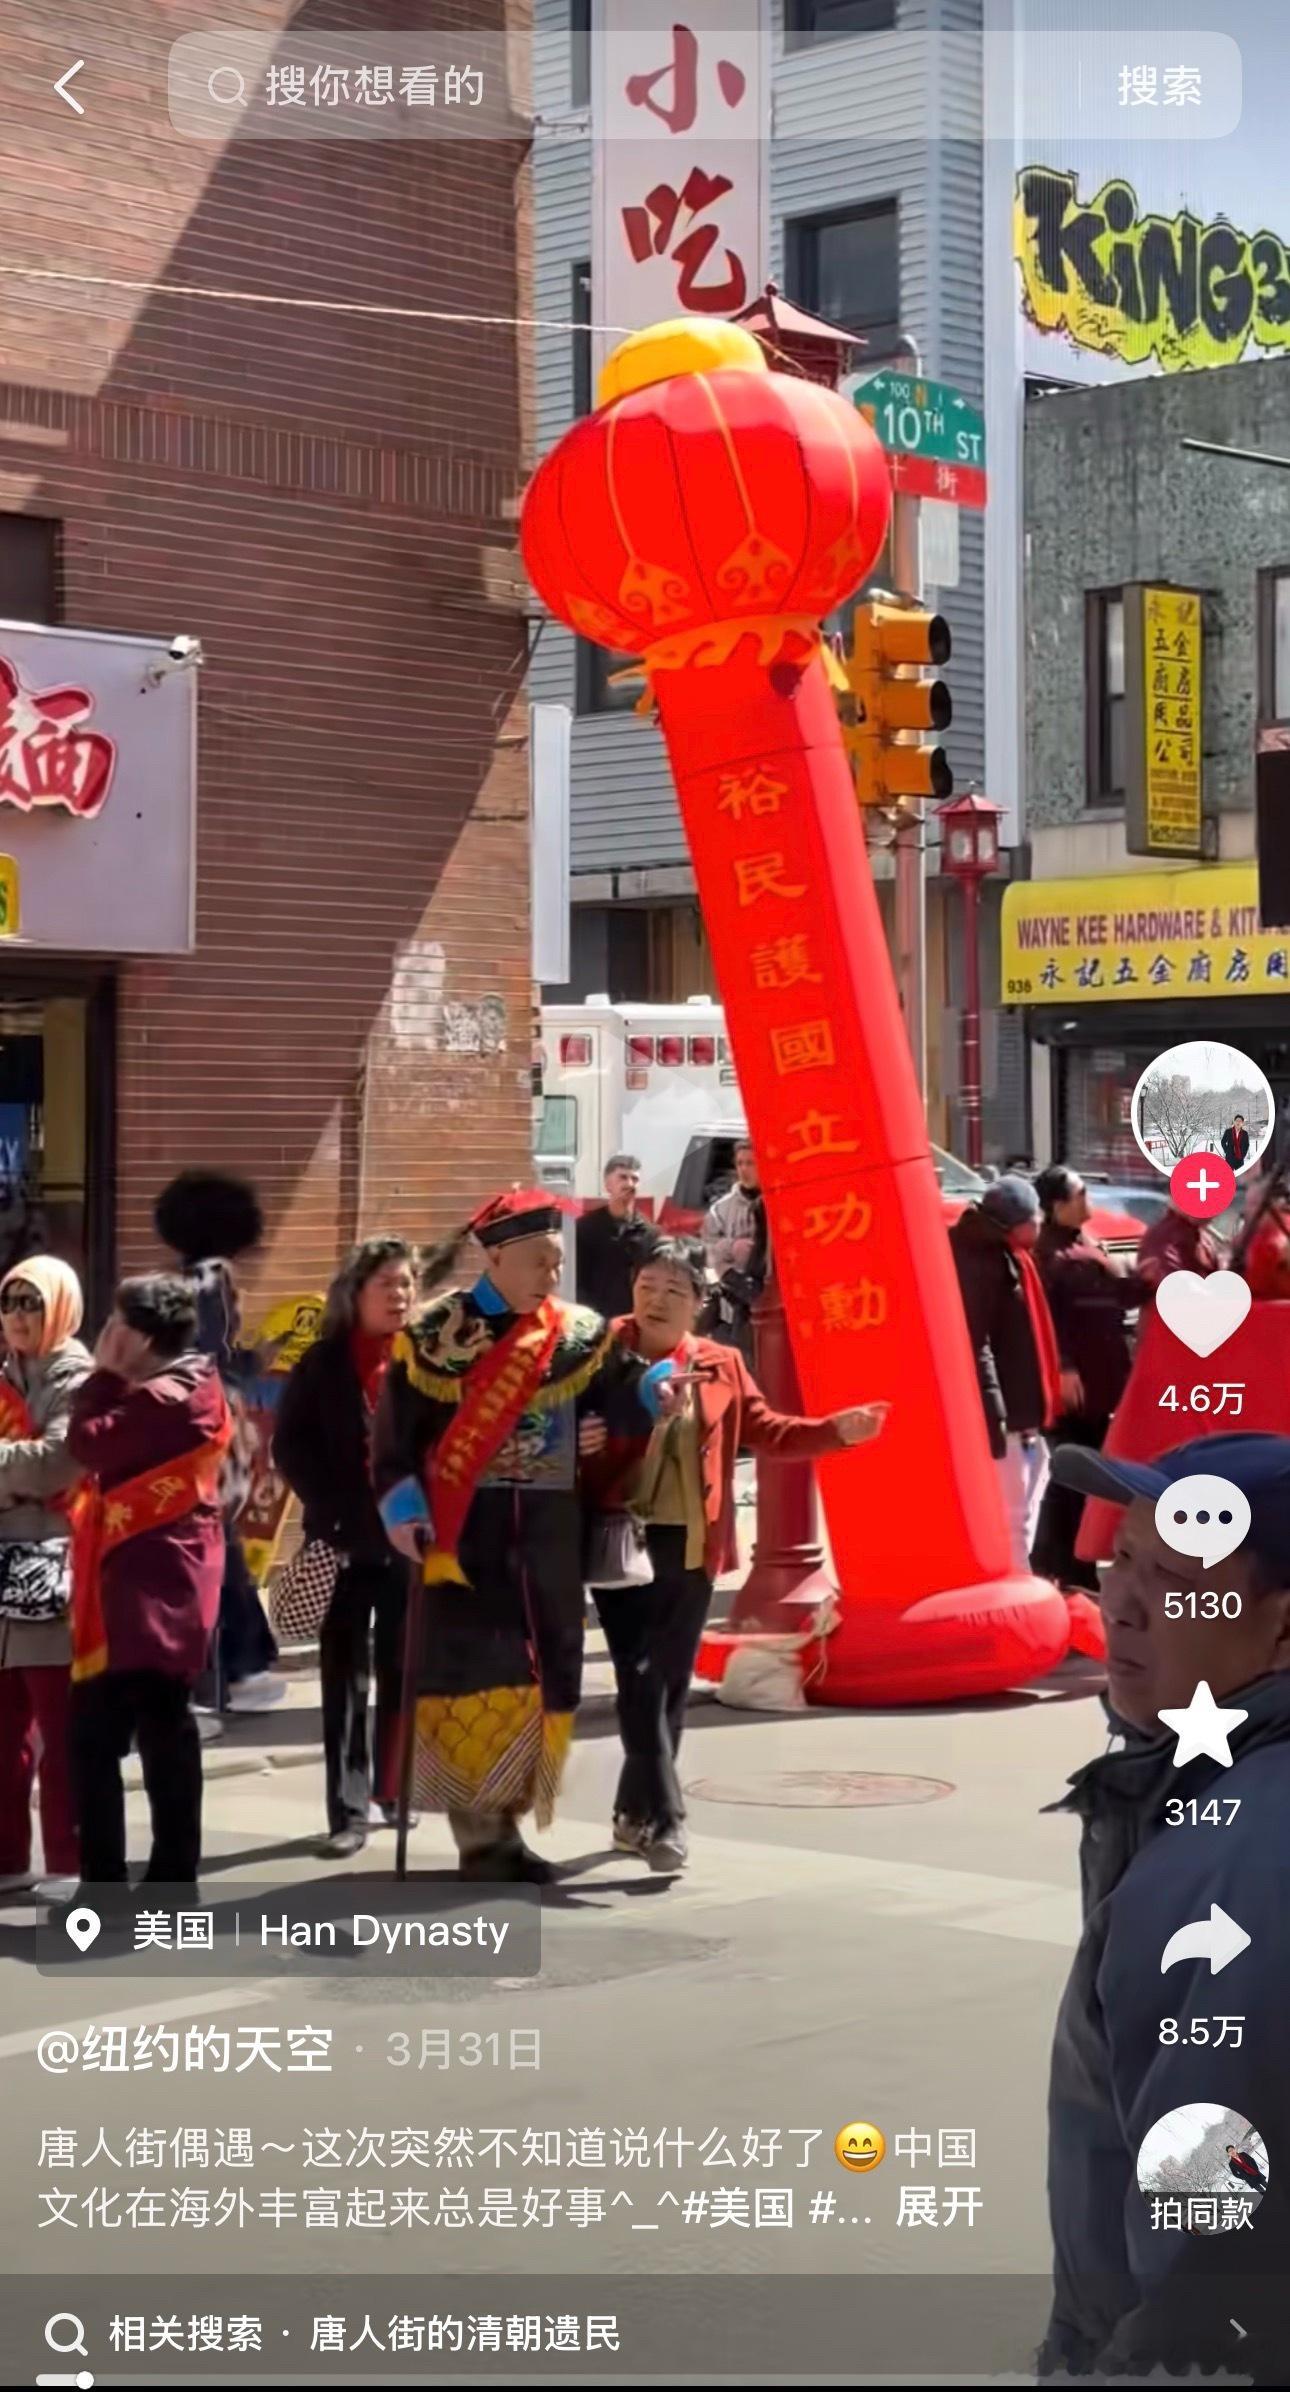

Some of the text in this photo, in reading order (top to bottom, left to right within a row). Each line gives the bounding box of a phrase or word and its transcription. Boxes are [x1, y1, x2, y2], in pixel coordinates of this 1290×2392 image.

[621, 23, 746, 313] 小吃
[883, 402, 982, 461] 10TH ST
[1152, 628, 1191, 657] 五金
[1017, 916, 1070, 949] WAYNE
[1076, 913, 1108, 946] KEE
[1113, 908, 1205, 944] HARDWARE
[1210, 907, 1222, 938] &
